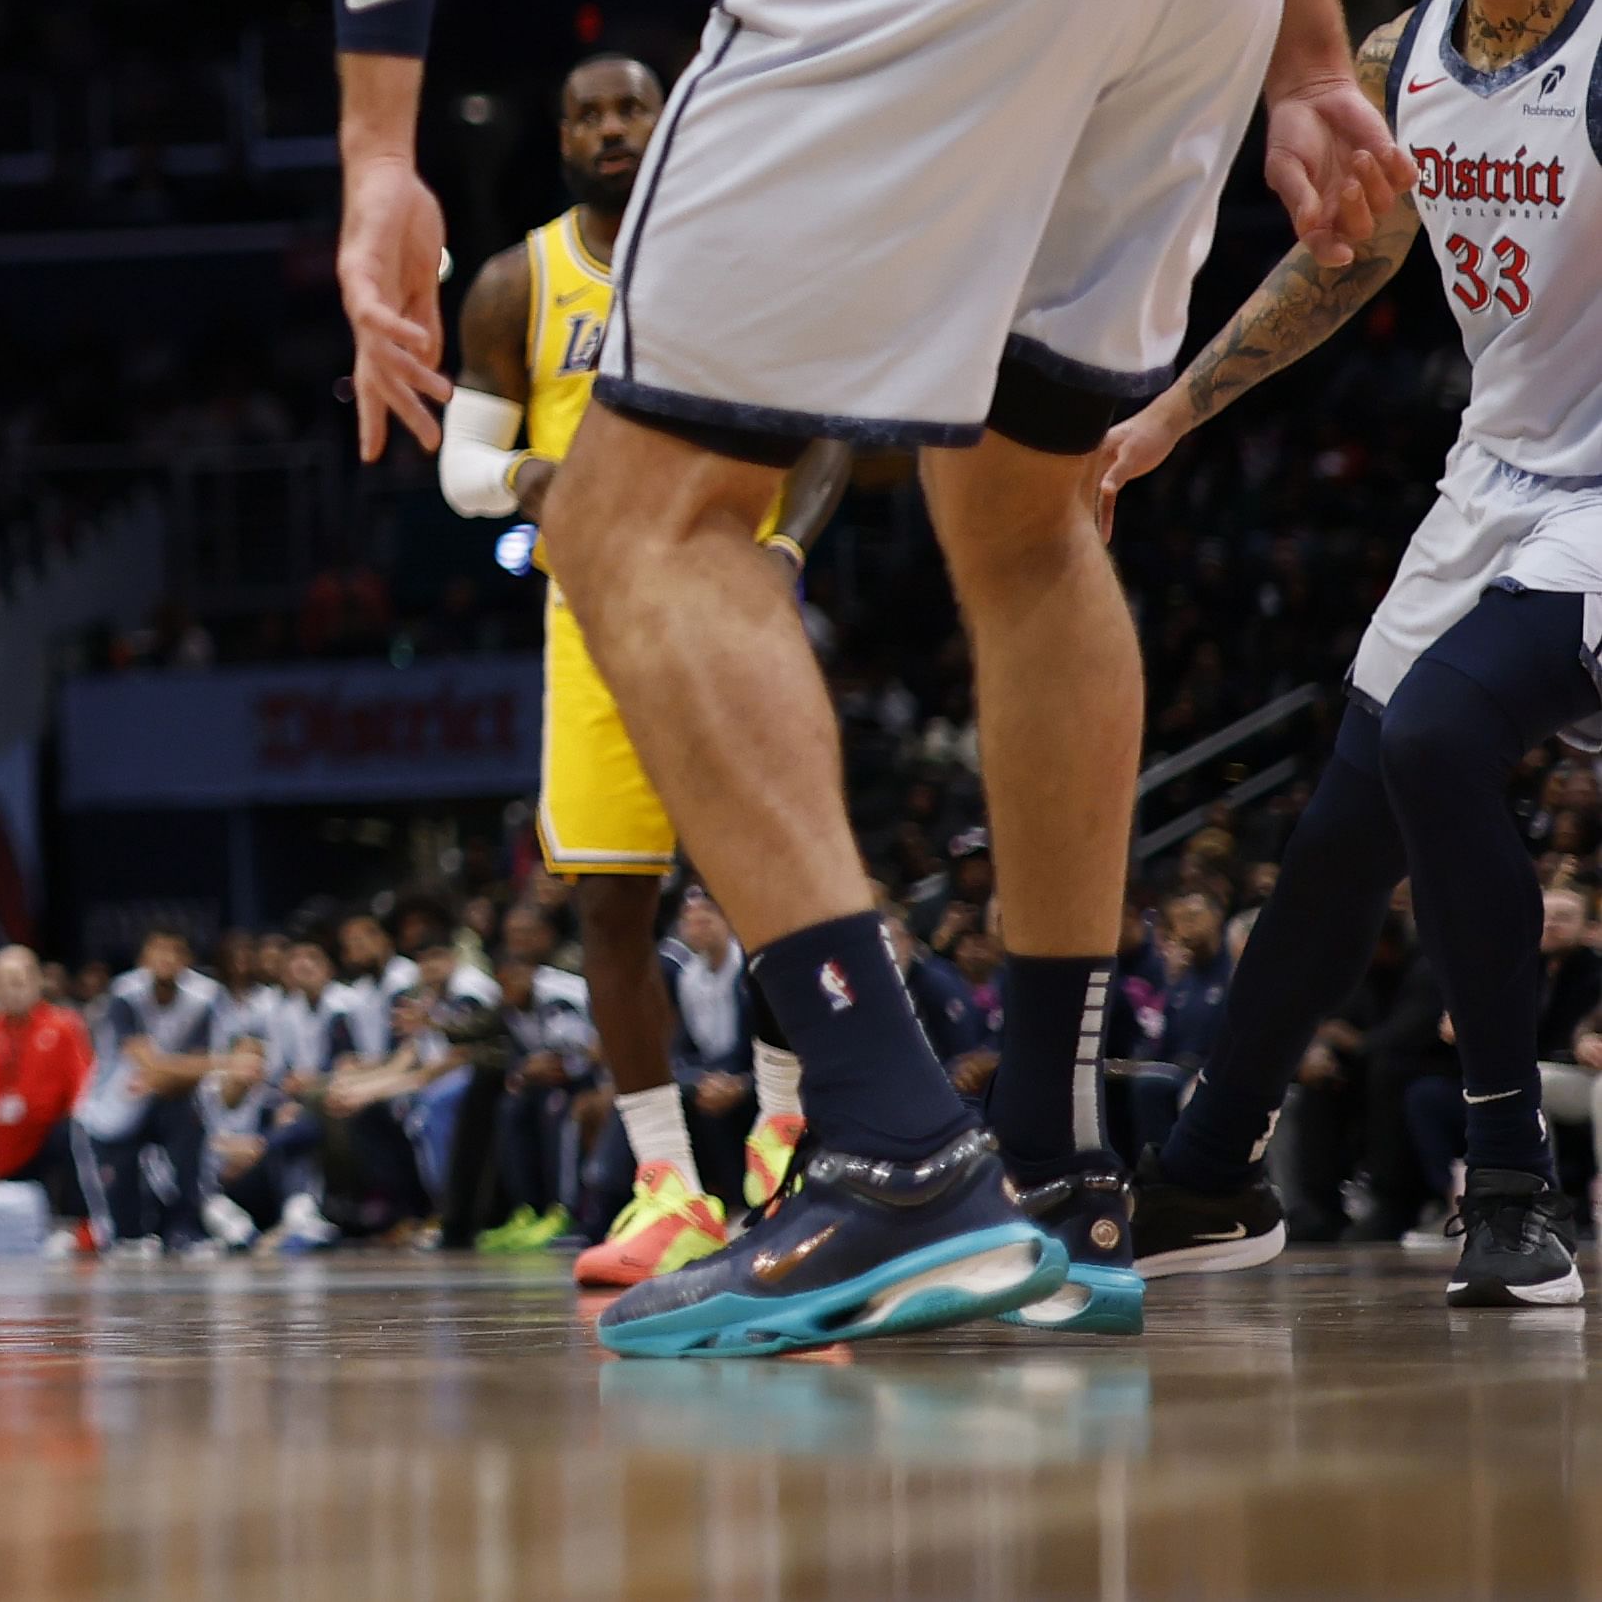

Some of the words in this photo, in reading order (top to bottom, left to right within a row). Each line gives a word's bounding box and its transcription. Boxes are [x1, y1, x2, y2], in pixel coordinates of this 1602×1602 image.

[1522, 104, 1576, 118] Robinhood
[1409, 141, 1566, 208] District
[1452, 206, 1559, 220] COLUMBIA
[1445, 233, 1532, 320] 33
